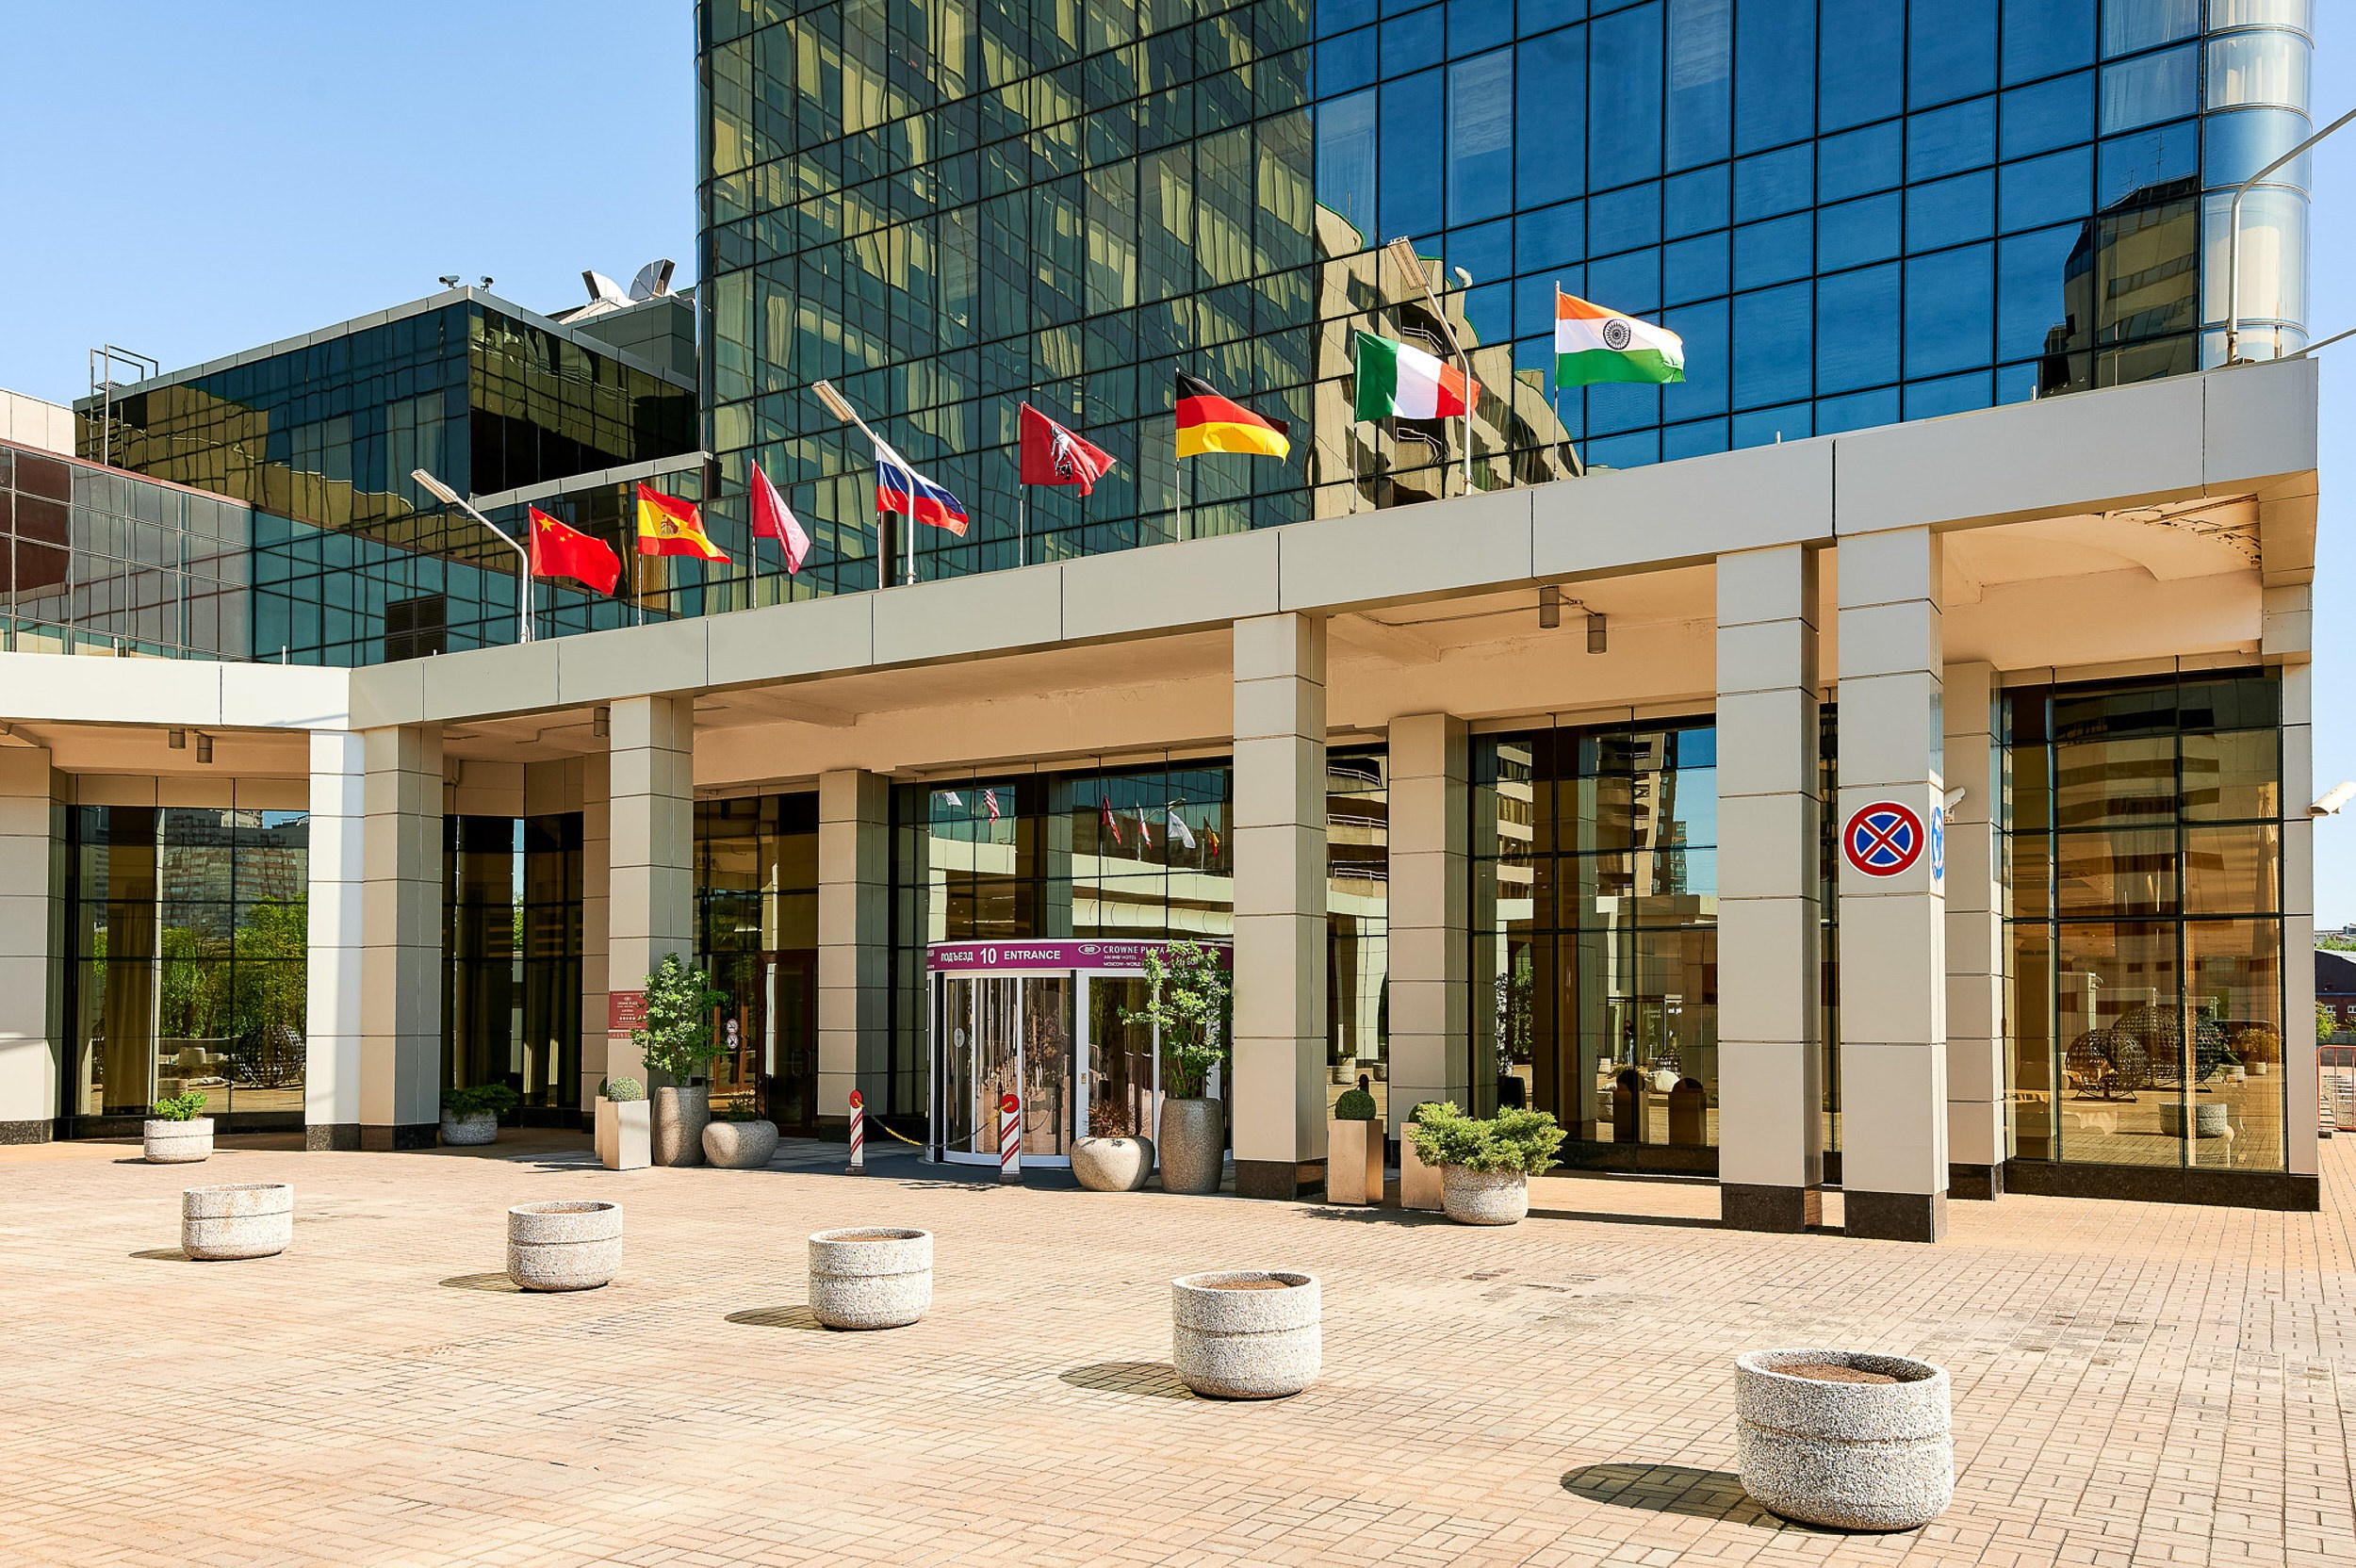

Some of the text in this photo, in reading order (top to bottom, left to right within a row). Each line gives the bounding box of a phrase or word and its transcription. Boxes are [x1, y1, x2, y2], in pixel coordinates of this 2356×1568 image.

[1103, 945, 1138, 954] CROWNE
[941, 951, 973, 962] ПОДЪЕЗД
[980, 948, 1061, 964] 10 ENTRANCE
